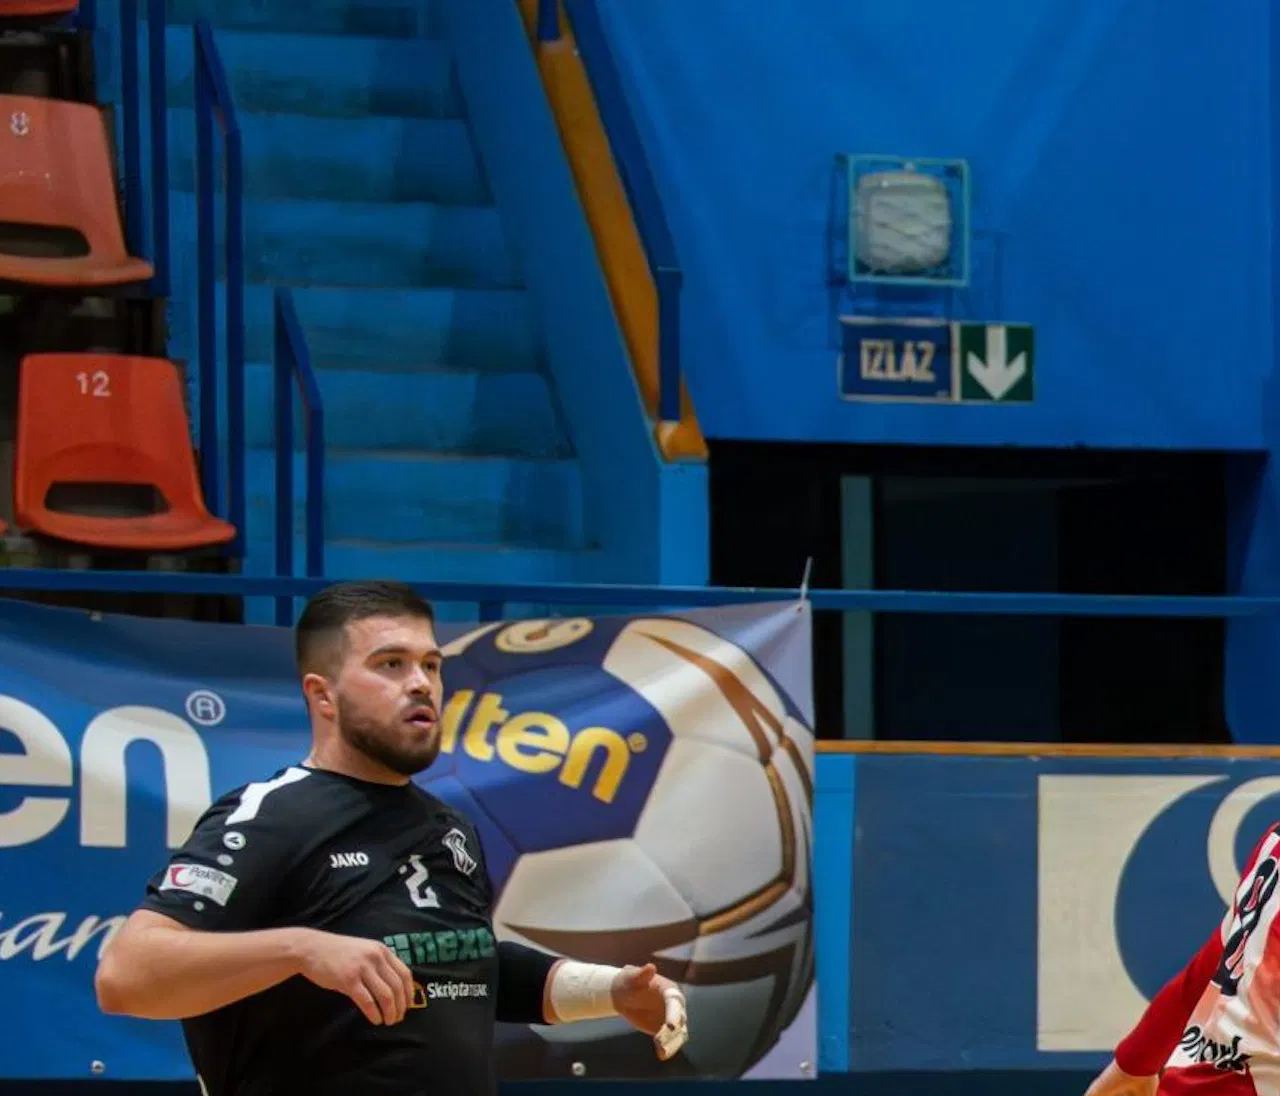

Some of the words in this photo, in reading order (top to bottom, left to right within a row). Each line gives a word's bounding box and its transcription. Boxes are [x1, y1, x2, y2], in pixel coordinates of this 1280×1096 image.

[860, 339, 936, 383] IZLAZ
[76, 370, 112, 397] 12
[329, 851, 370, 869] JAKO
